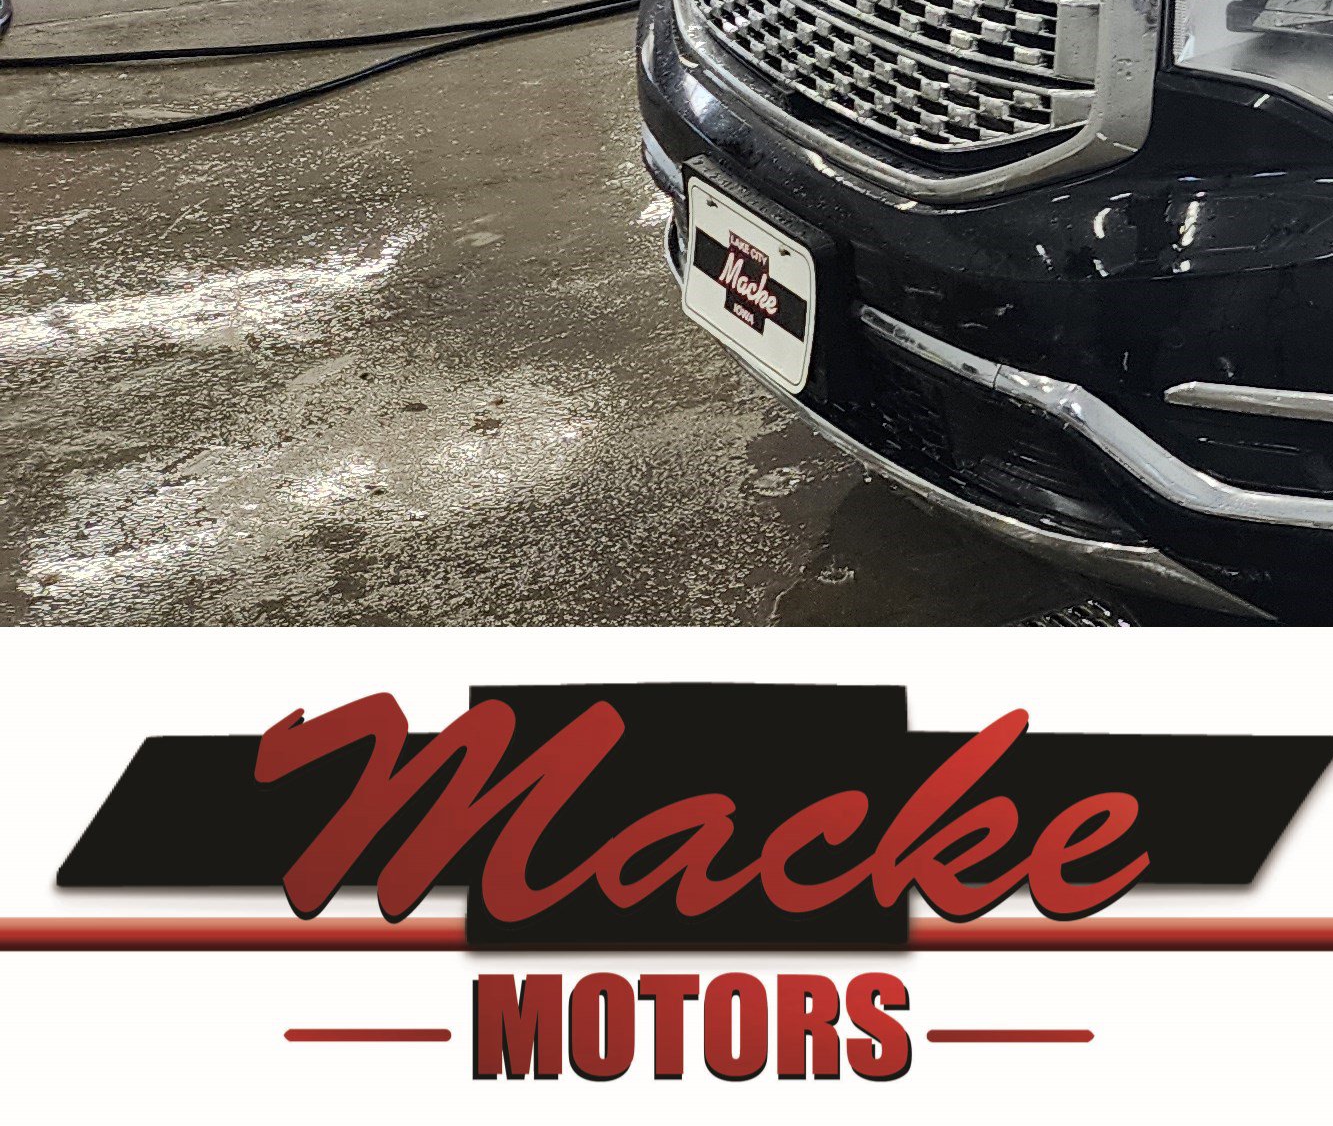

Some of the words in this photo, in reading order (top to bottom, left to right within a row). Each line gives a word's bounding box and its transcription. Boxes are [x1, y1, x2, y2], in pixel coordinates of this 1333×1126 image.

[730, 235, 750, 255] LAKE
[750, 248, 768, 265] CITY
[719, 252, 778, 315] Macke
[733, 303, 755, 325] IOWA
